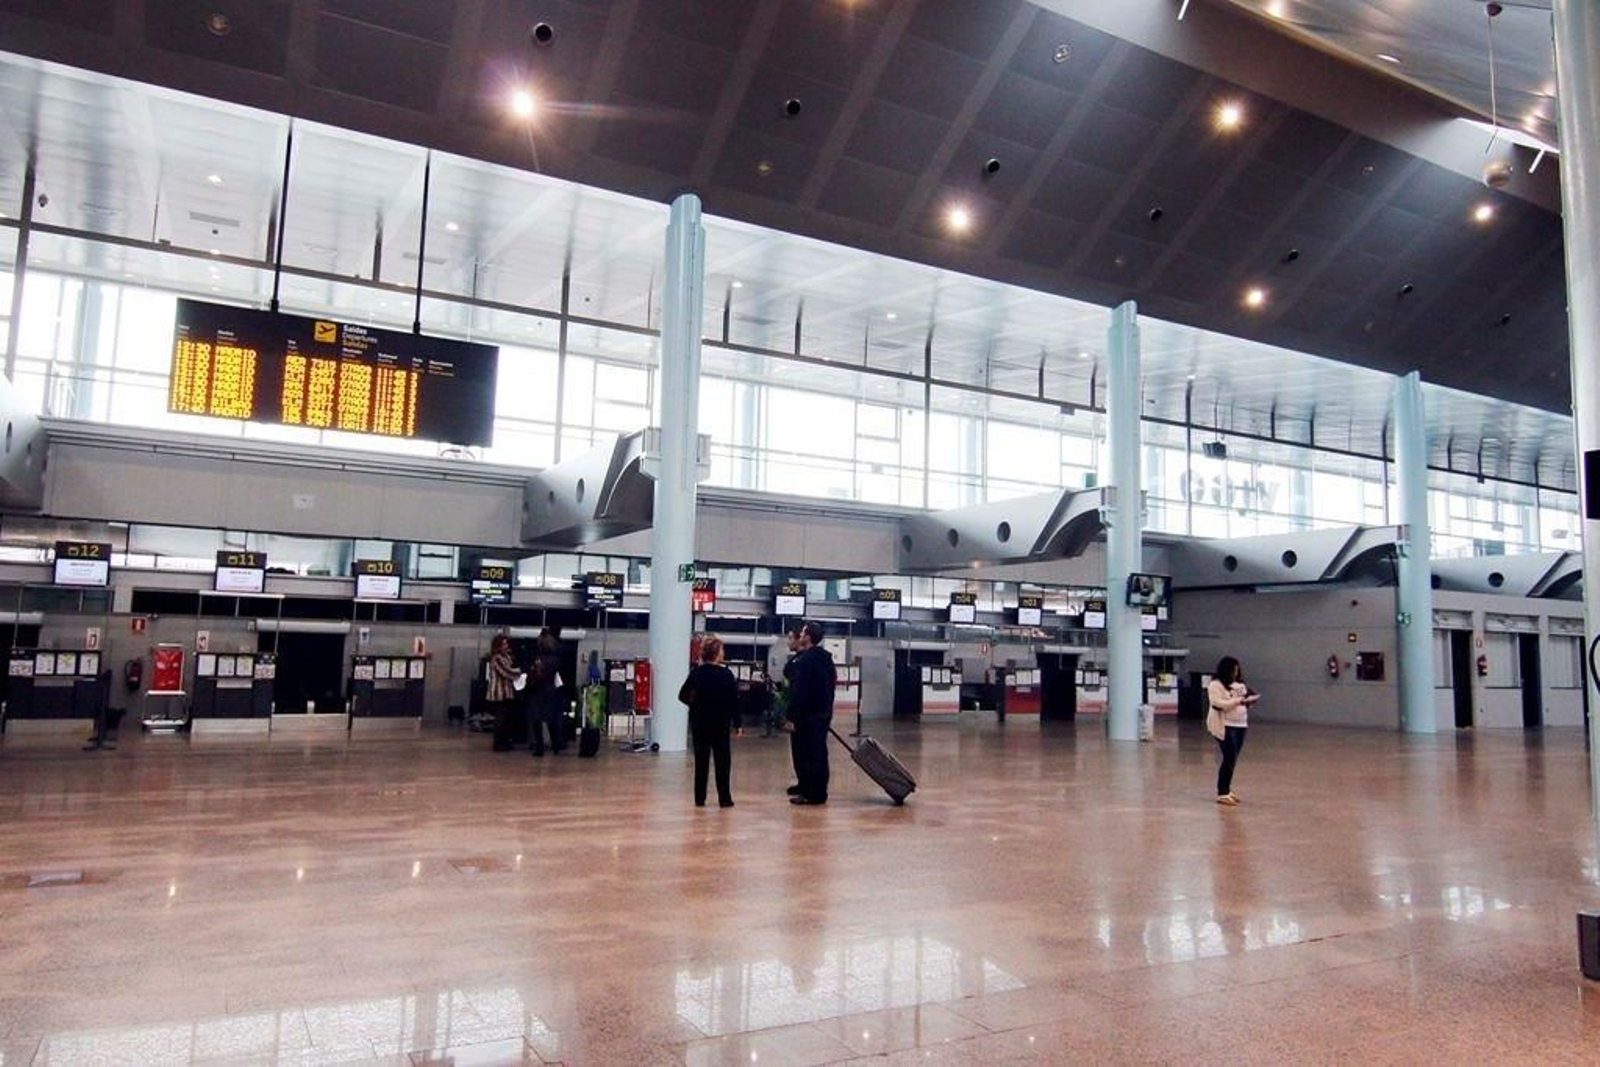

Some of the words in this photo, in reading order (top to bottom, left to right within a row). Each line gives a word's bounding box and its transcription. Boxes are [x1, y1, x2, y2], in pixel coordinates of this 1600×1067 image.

[80, 545, 99, 558] 12
[239, 553, 256, 567] 11
[377, 562, 393, 574] 10
[490, 568, 504, 580] 09
[603, 574, 617, 585] 08
